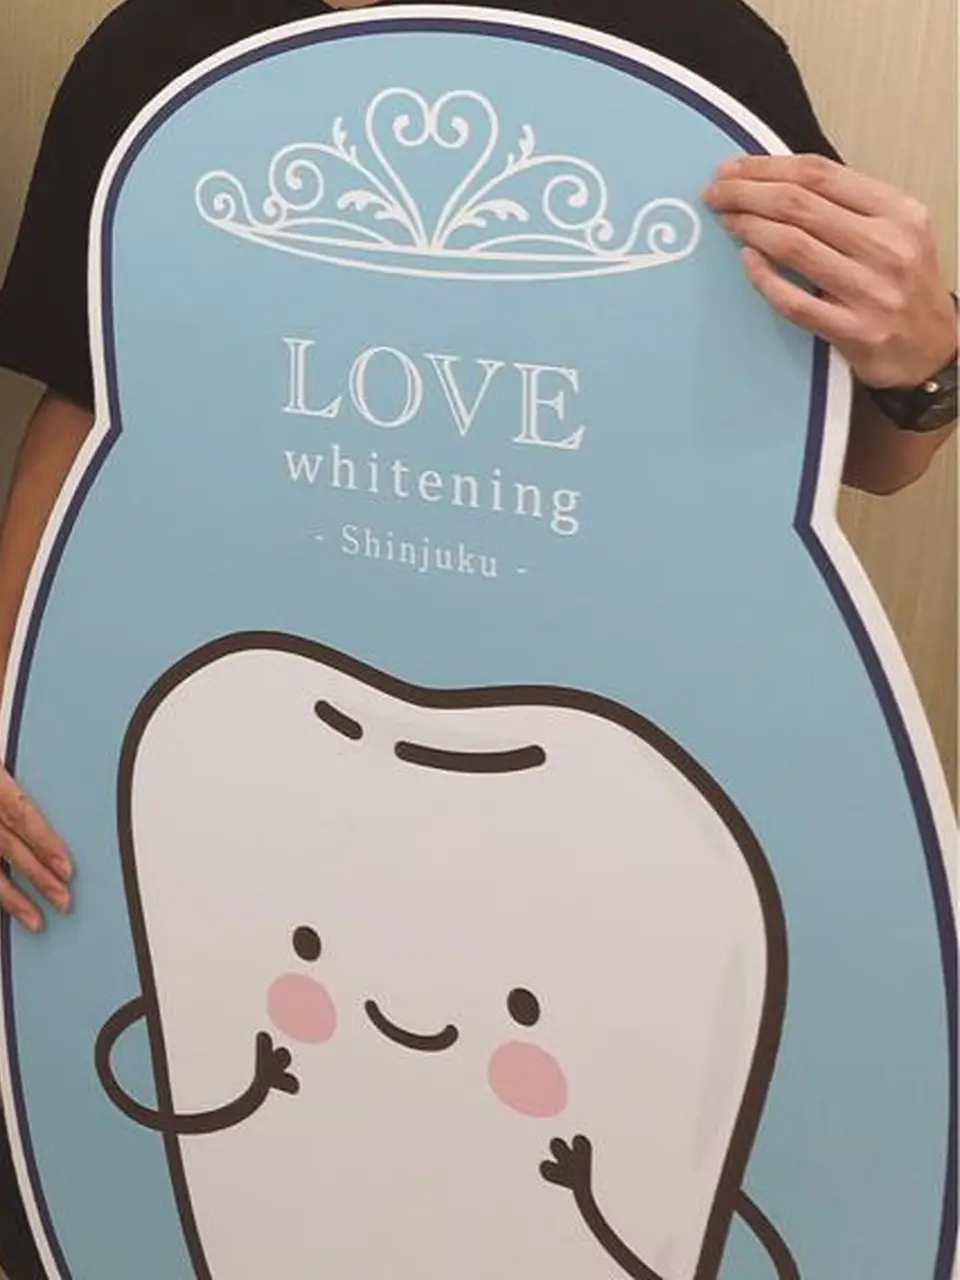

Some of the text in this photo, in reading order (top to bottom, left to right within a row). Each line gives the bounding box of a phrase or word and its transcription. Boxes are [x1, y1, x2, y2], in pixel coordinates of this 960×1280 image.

[281, 336, 587, 450] LOVE
[283, 443, 581, 536] whitening
[341, 524, 498, 578] Shinjuku
